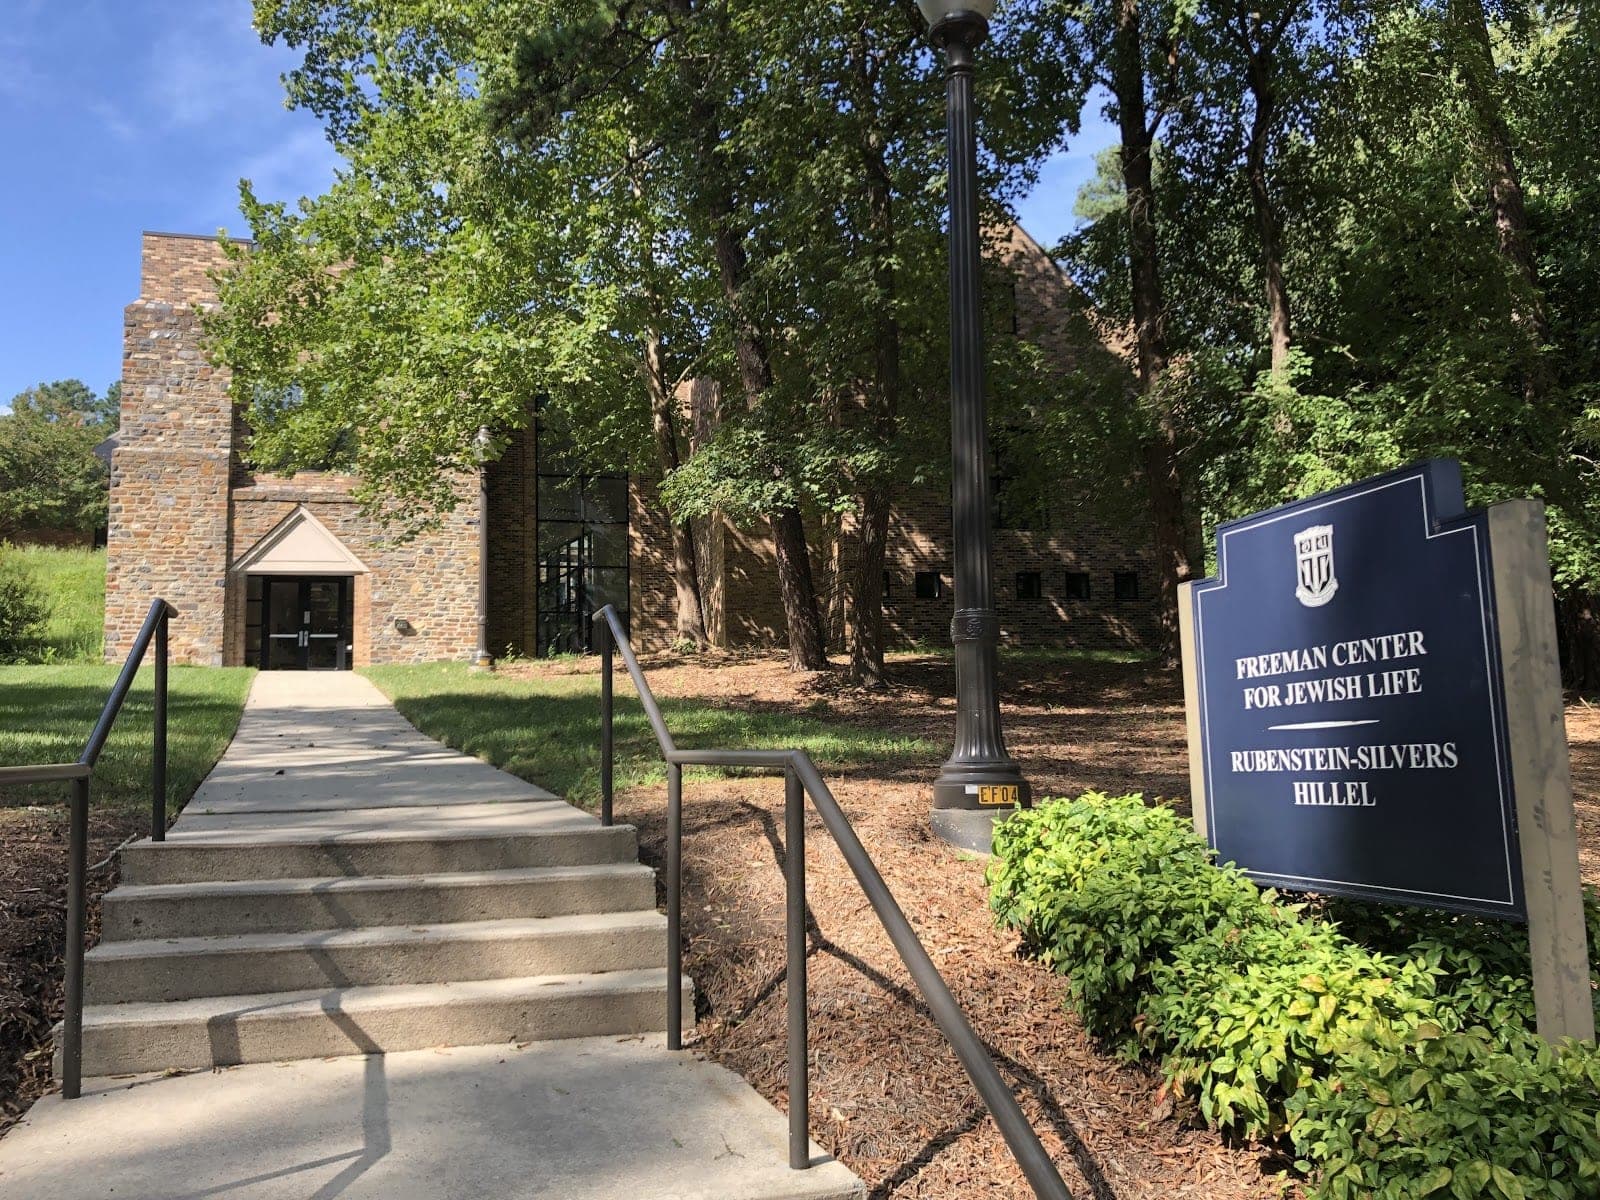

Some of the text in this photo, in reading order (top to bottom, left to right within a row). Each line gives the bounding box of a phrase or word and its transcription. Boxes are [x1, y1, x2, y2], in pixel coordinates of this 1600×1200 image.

[1235, 630, 1427, 680] FREEMAN CENTER
[1243, 668, 1423, 709] FOR JEWISH LIFE
[1230, 742, 1459, 772] RUBENSTEIN-SILVERS
[1293, 781, 1377, 807] HILLEL
